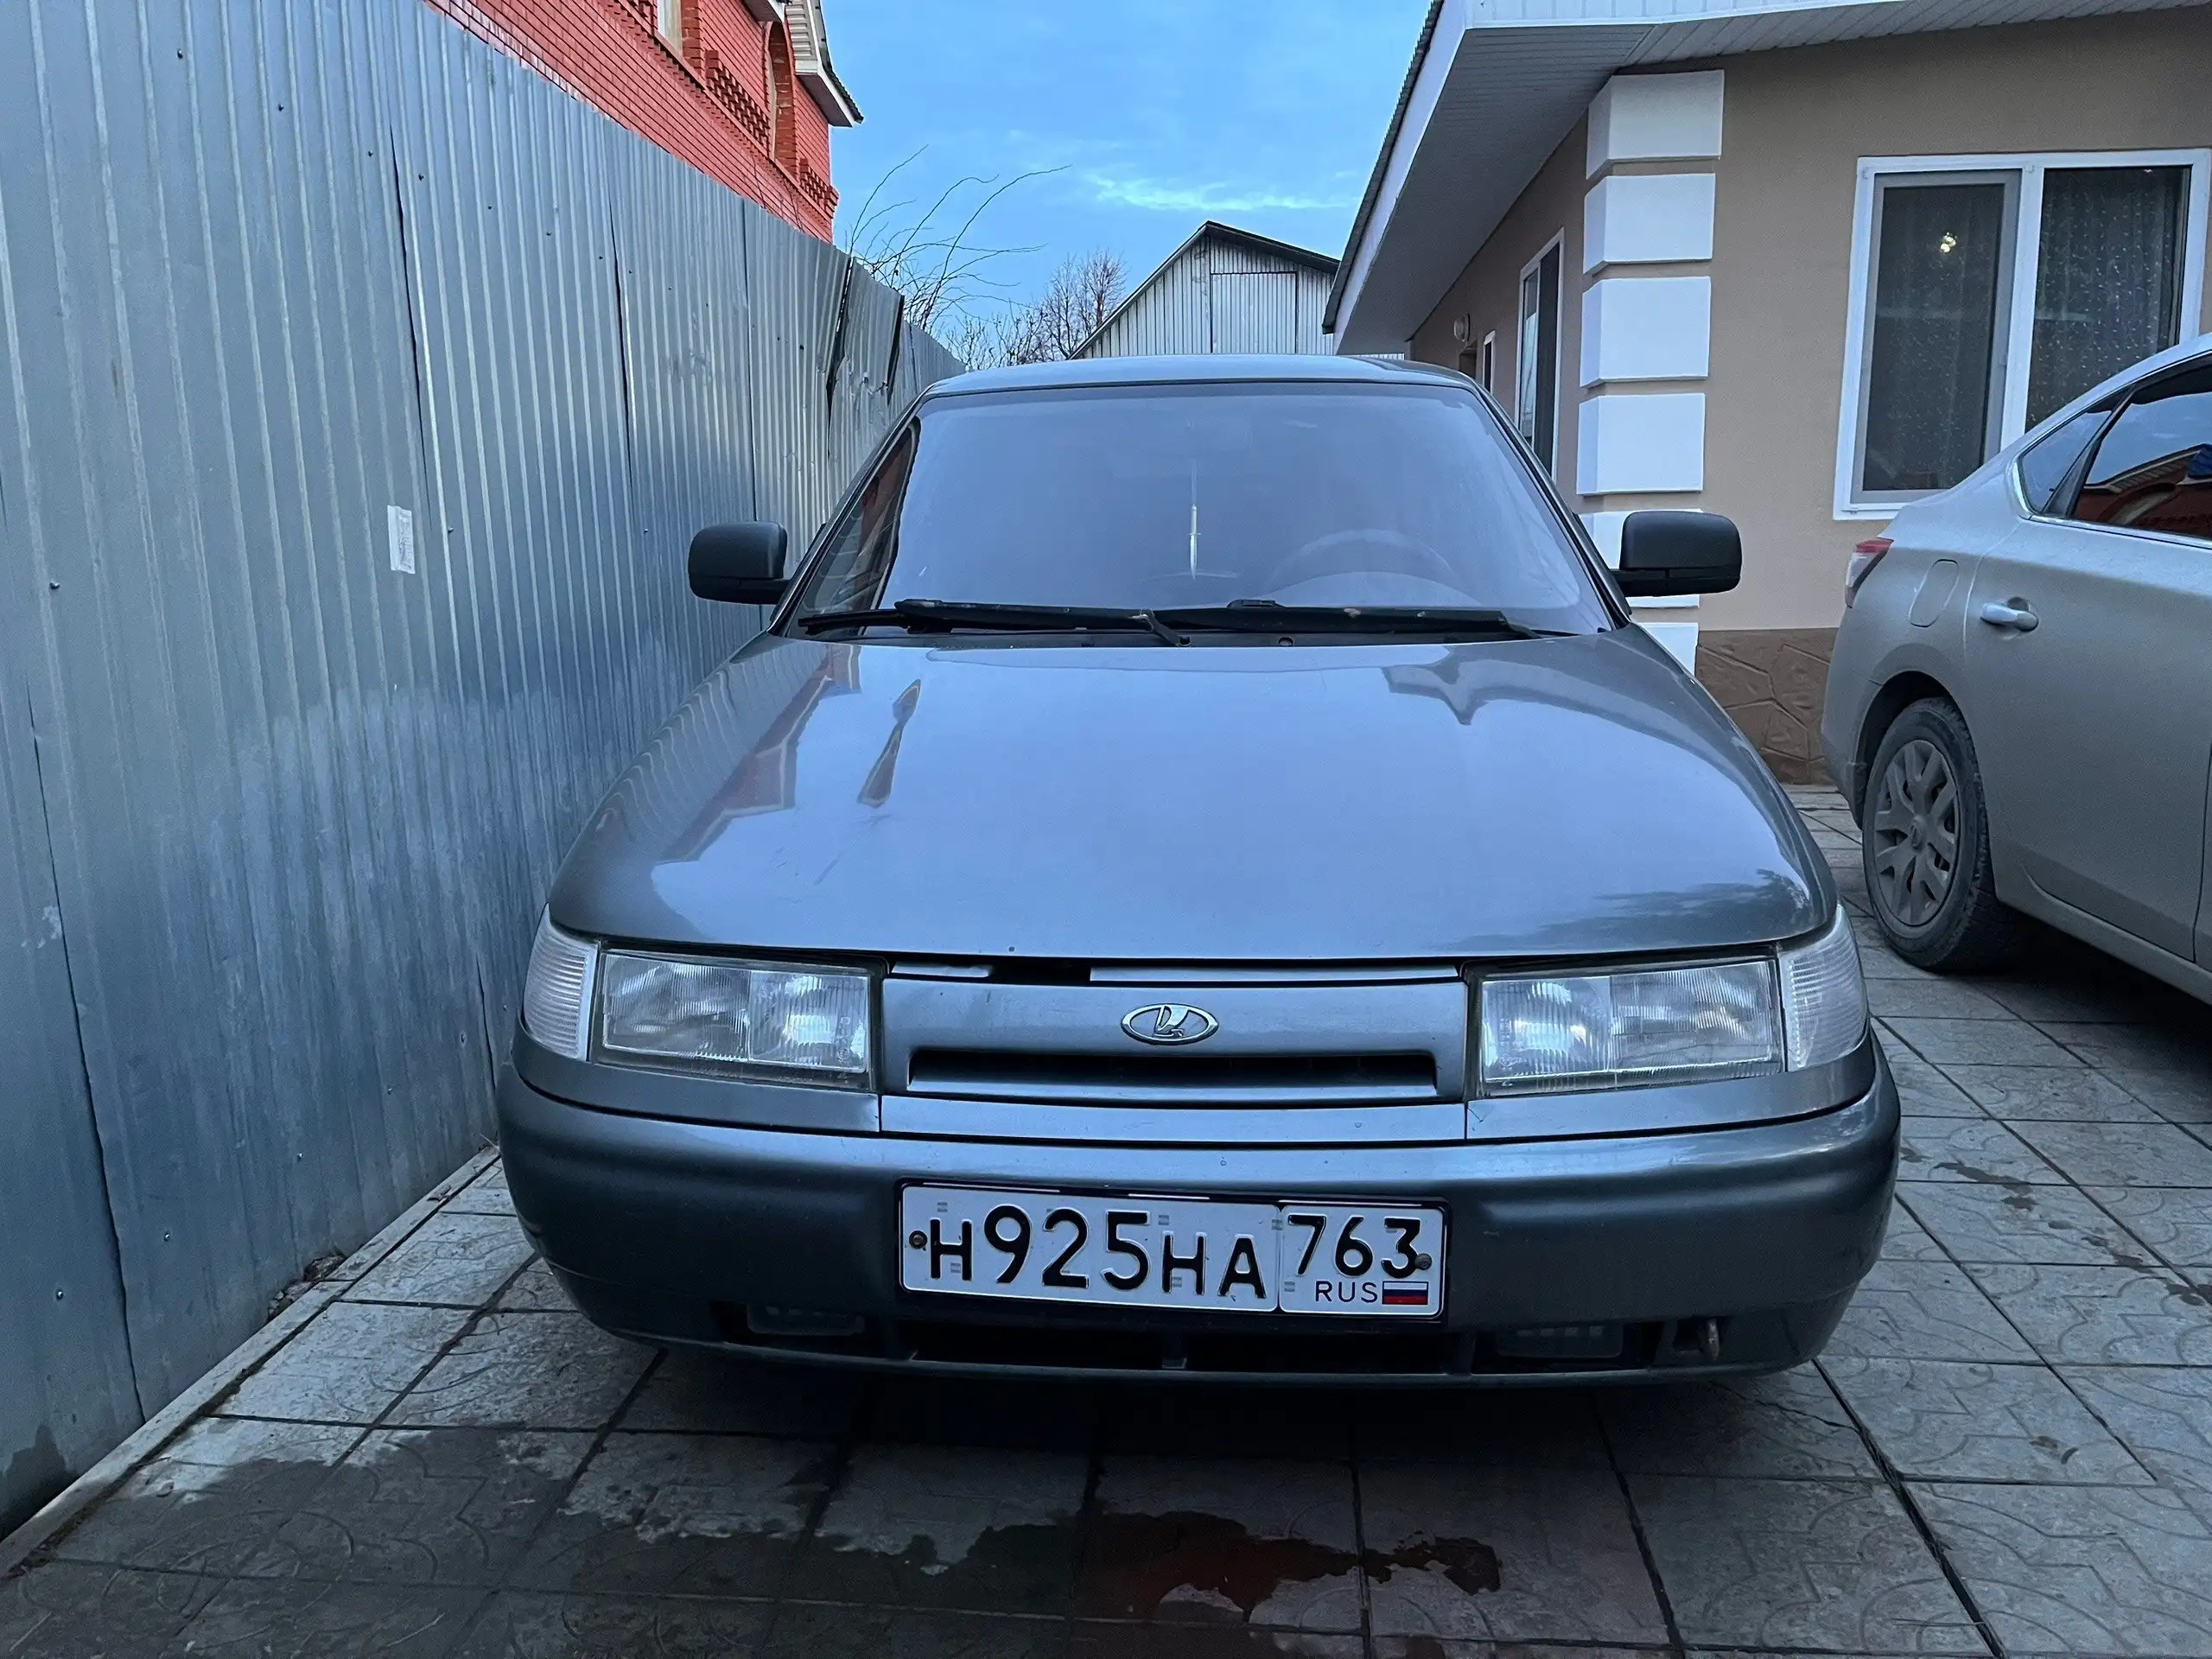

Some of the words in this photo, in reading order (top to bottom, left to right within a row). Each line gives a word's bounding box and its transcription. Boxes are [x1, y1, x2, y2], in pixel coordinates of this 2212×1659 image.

[929, 1205, 1267, 1300] Н925НА
[1287, 1212, 1421, 1279] 763
[1313, 1280, 1379, 1304] RUS
